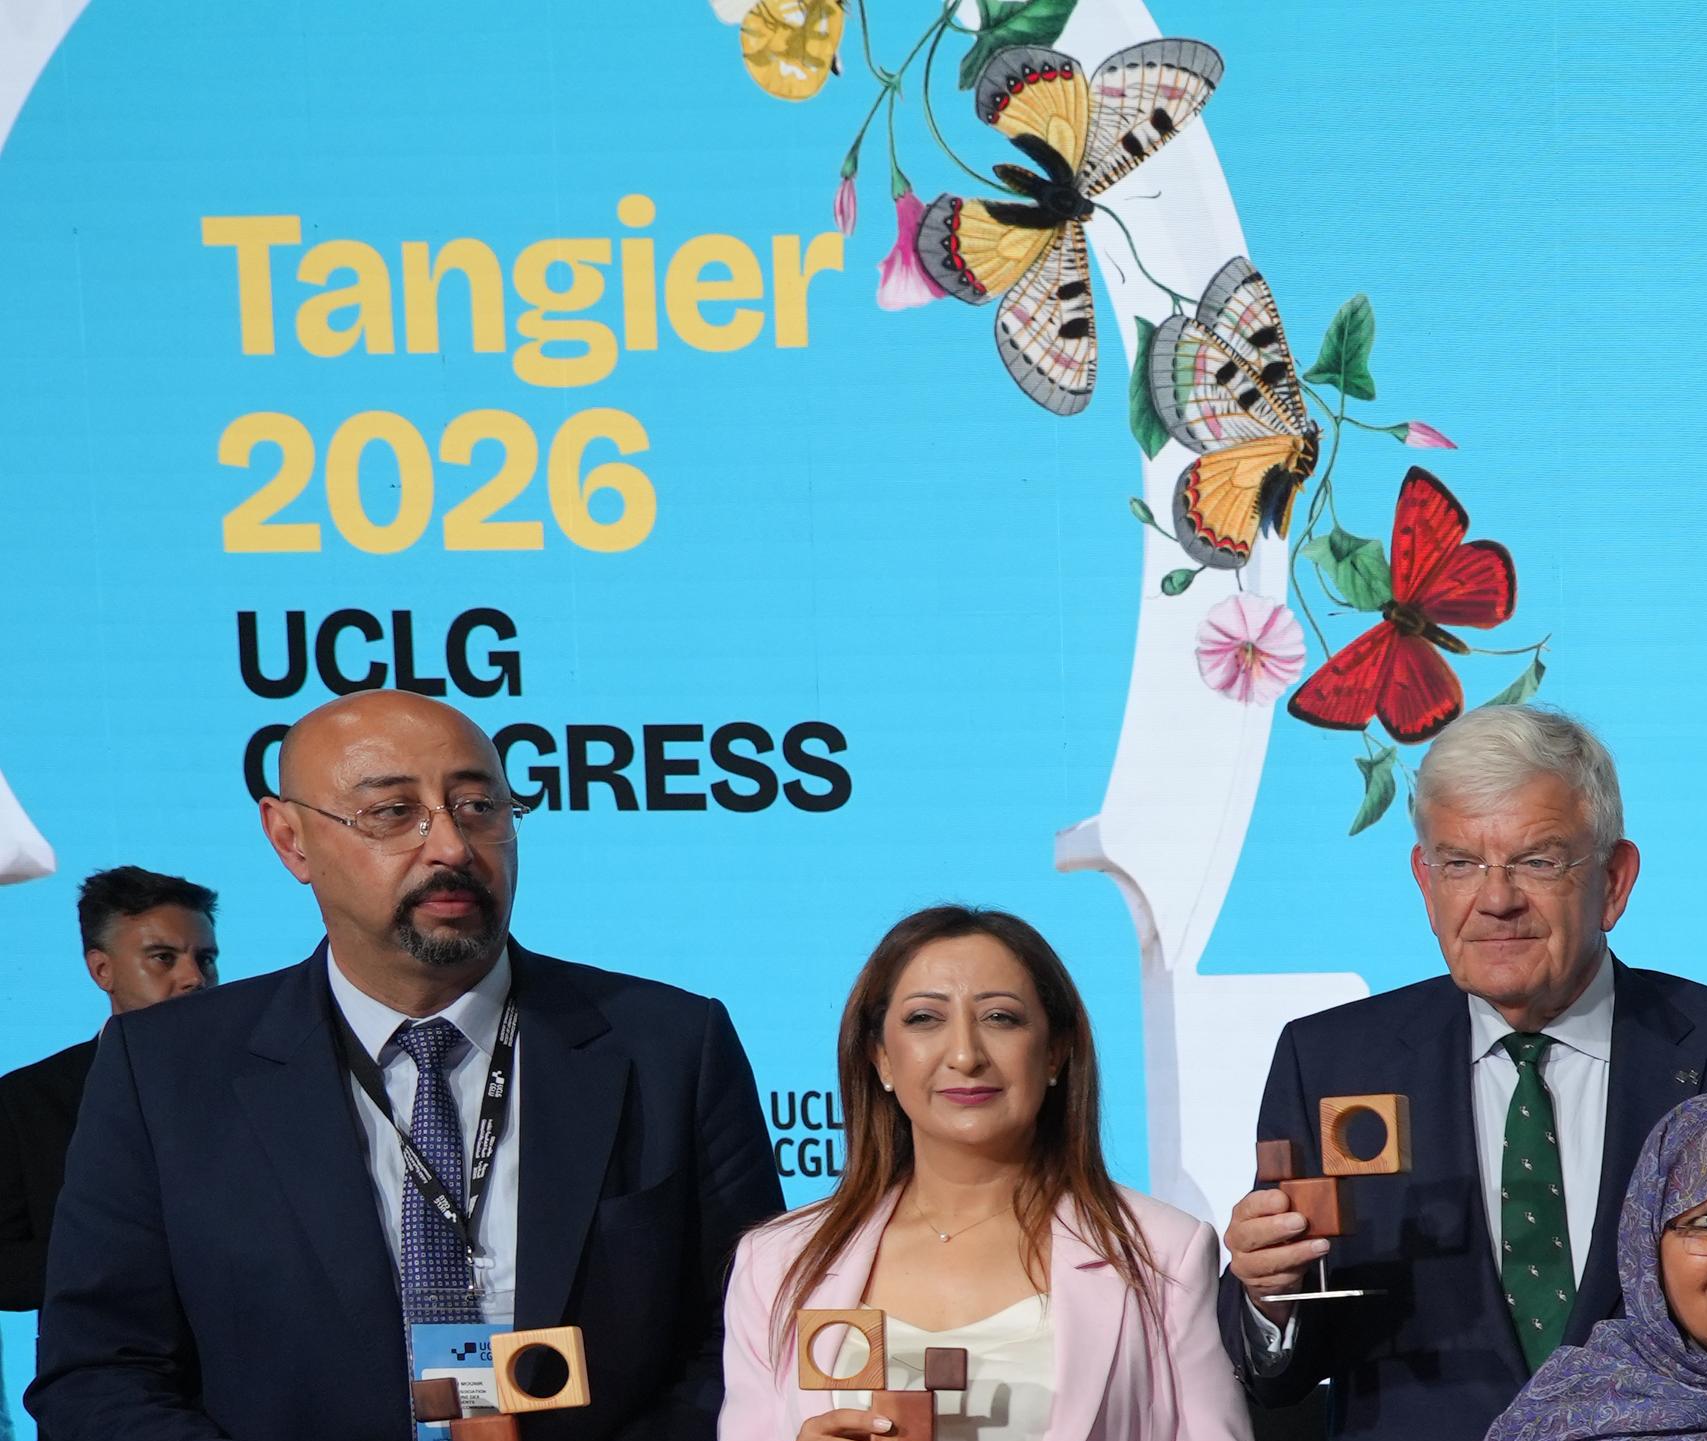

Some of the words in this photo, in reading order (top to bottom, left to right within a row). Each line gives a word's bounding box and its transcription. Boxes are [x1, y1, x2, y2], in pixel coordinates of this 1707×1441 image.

[201, 194, 845, 388] Tangier
[217, 407, 658, 555] 2026
[236, 608, 523, 700] UCLG
[243, 721, 853, 813] GRESS
[771, 1091, 845, 1131] UCL
[774, 1137, 844, 1178] CGL
